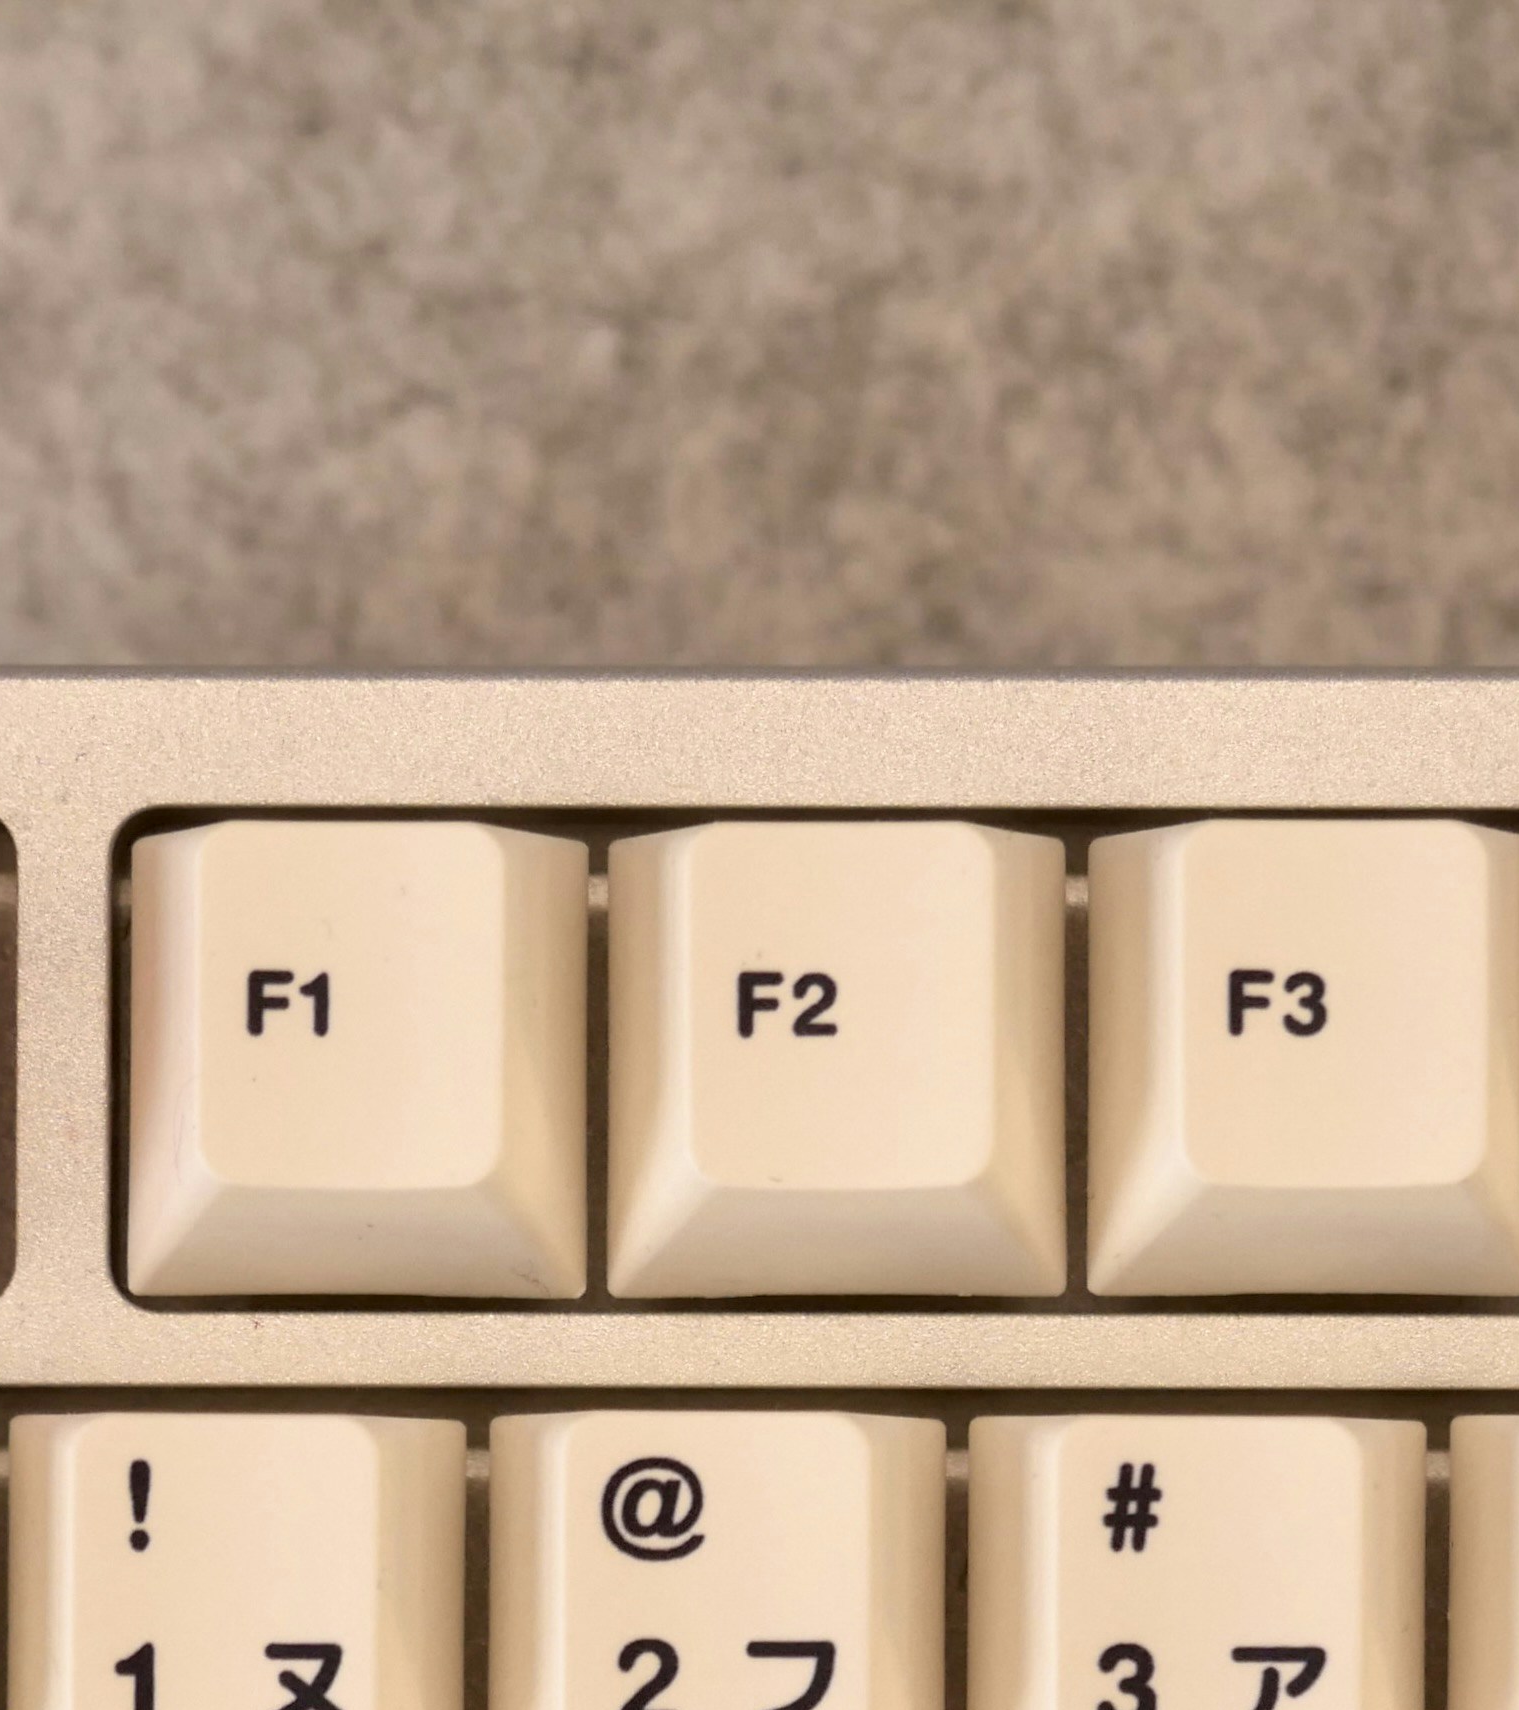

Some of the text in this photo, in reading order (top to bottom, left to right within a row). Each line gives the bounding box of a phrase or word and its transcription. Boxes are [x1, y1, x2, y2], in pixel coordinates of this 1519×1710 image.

[246, 968, 330, 1038] F1
[737, 970, 838, 1039] F2
[1227, 968, 1328, 1038] F3
[128, 1458, 152, 1553] !
[600, 1456, 706, 1563] @
[1102, 1461, 1163, 1553] #
